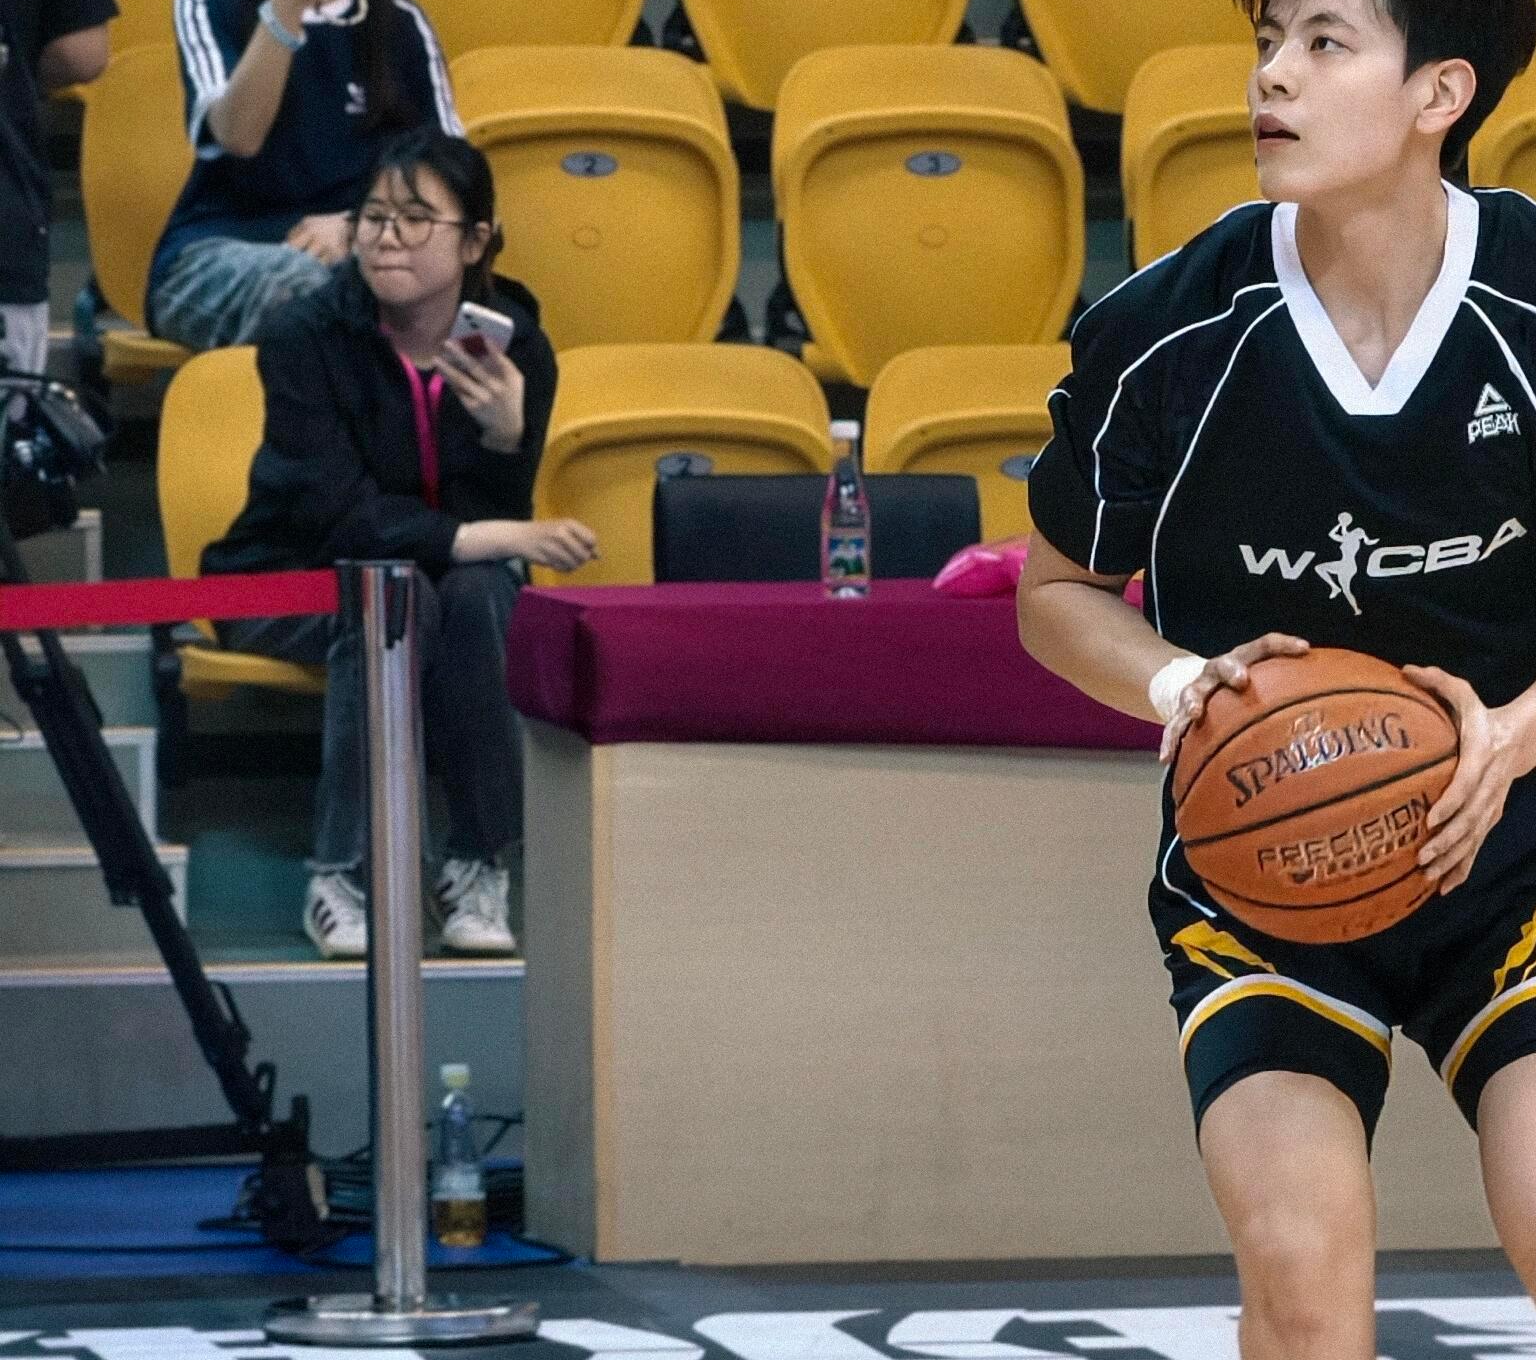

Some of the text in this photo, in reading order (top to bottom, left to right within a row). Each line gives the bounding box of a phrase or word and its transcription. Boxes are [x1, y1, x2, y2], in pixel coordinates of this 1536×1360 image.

[1467, 412, 1521, 444] PEAK
[1225, 712, 1410, 808] SPALDING
[1256, 792, 1431, 872] PRECISION
